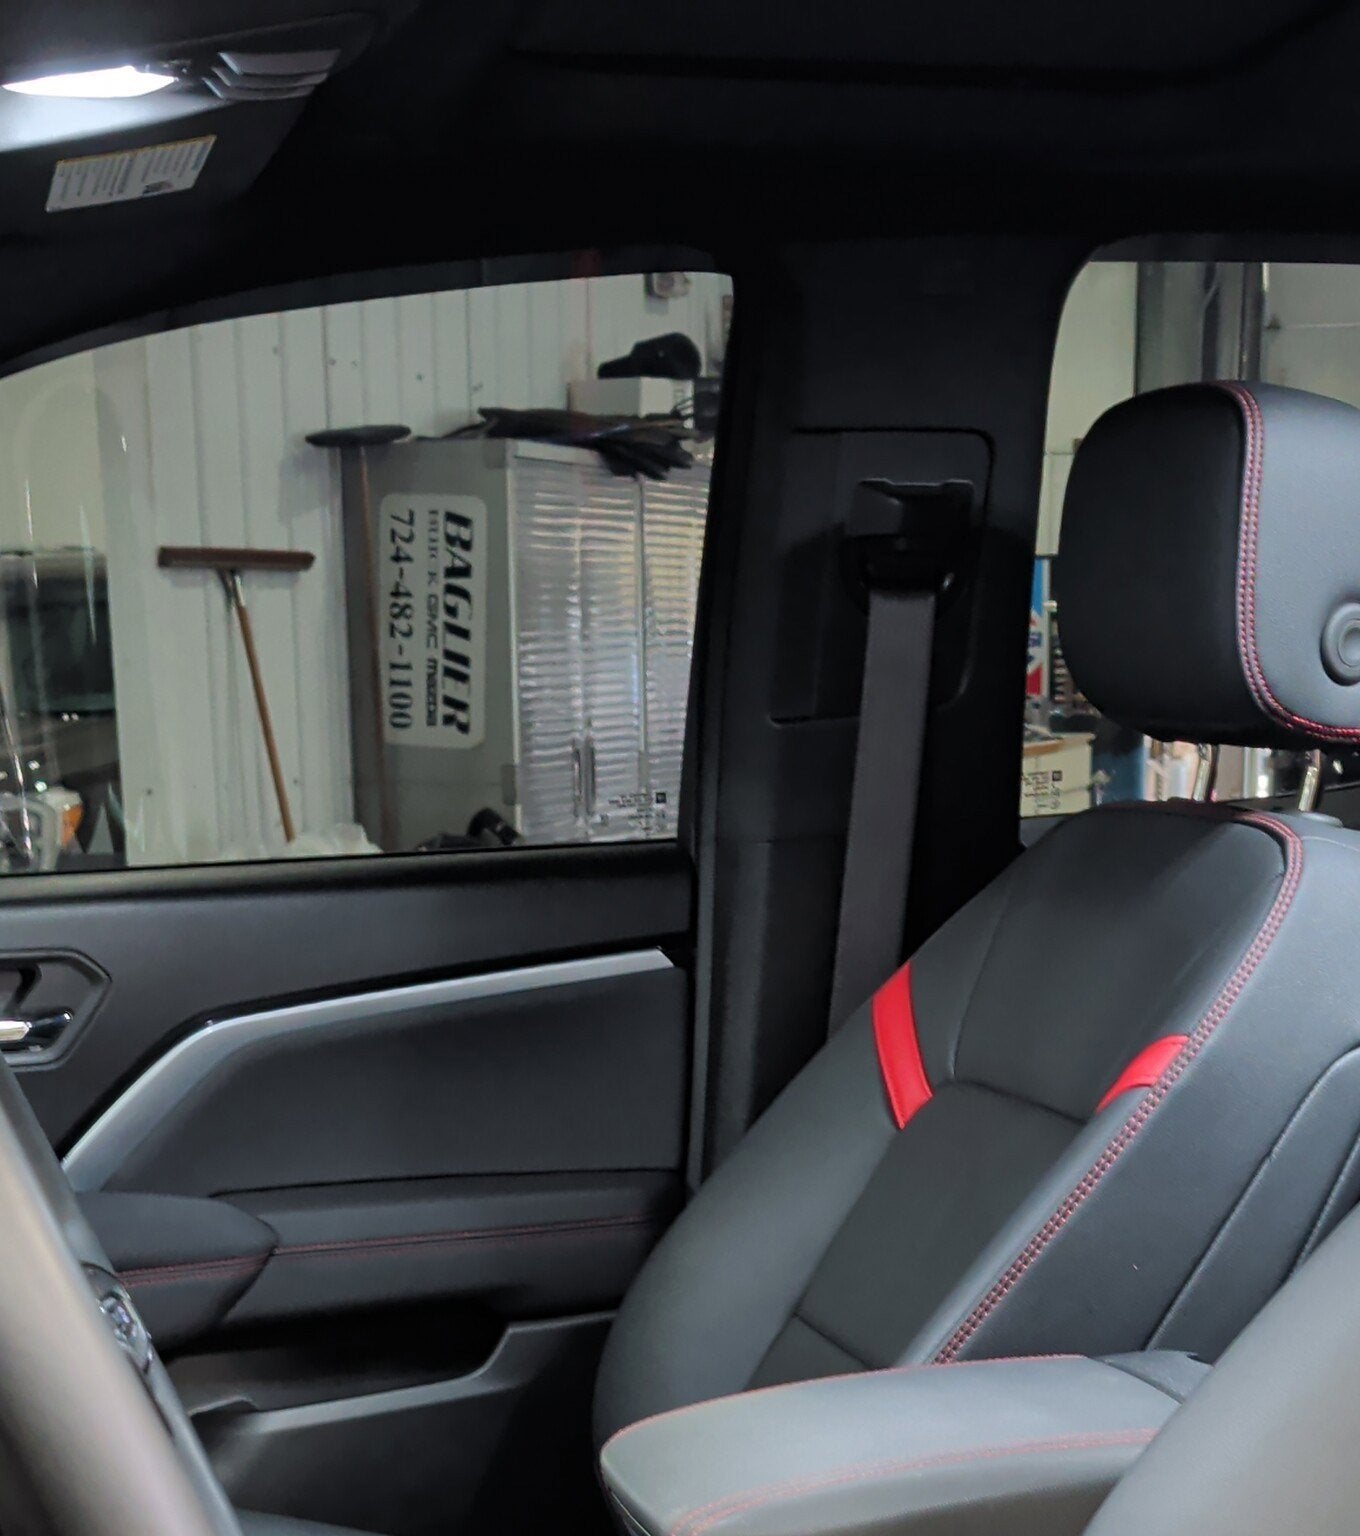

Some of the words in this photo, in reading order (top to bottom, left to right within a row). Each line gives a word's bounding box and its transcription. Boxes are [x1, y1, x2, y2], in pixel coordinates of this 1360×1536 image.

[389, 508, 415, 730] 724-482-1100
[426, 592, 439, 650] GMC
[442, 510, 473, 735] BAGLIER
